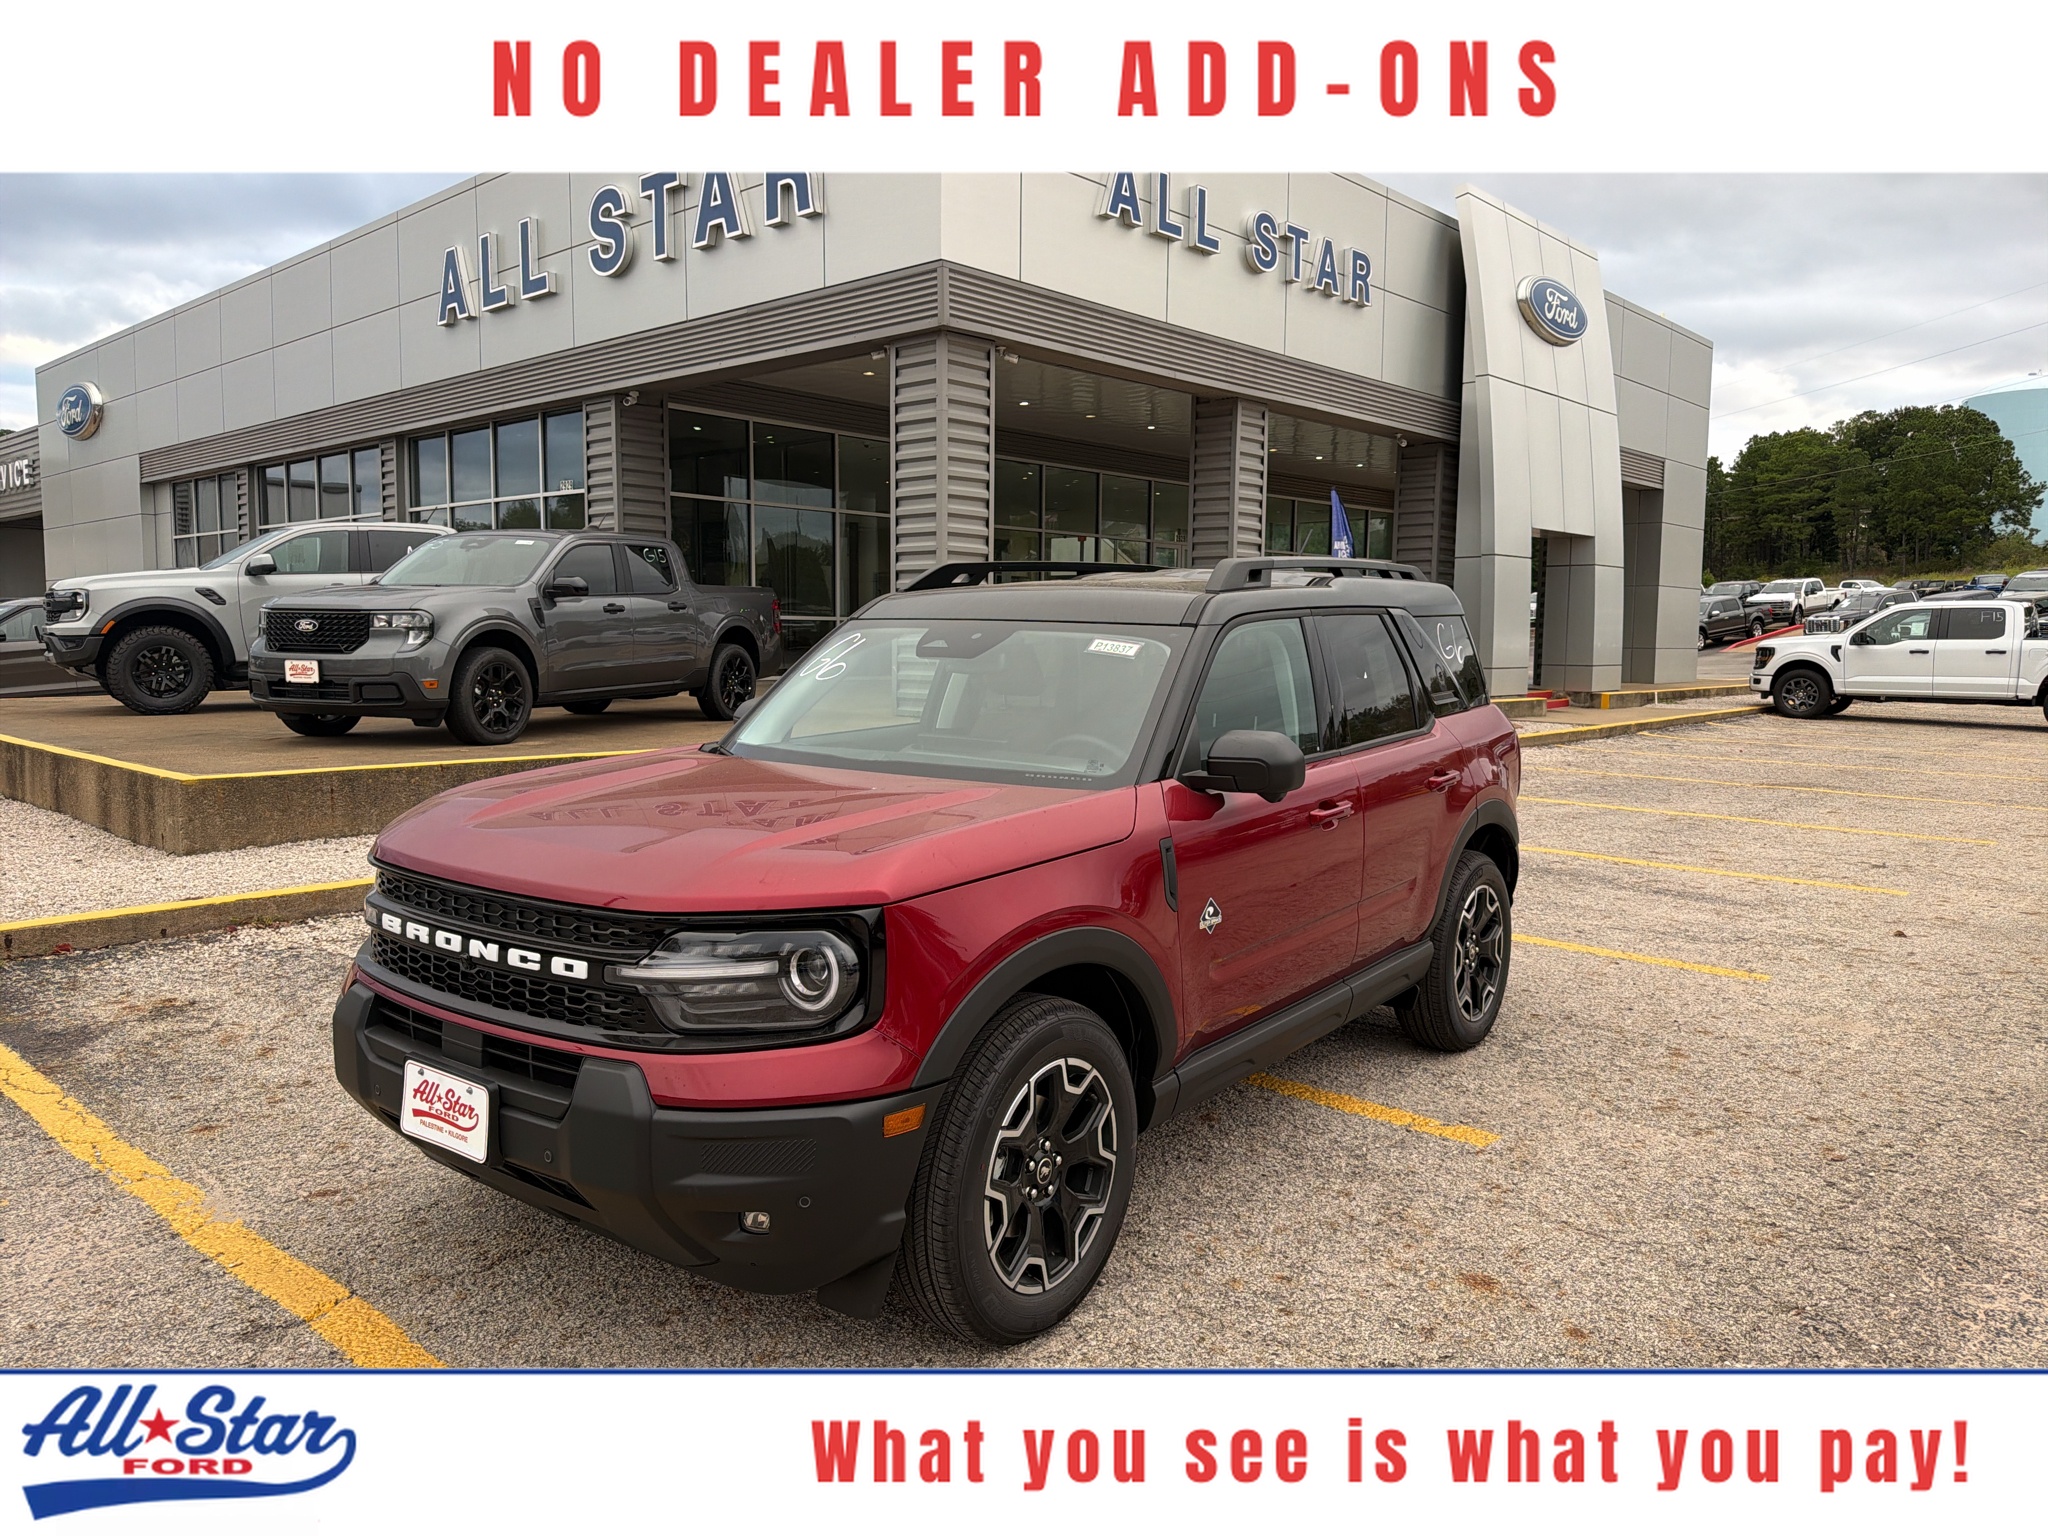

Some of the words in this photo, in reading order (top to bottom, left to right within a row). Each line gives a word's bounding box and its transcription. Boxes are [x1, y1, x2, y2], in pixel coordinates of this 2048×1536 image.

[437, 217, 557, 327] ALL
[588, 172, 823, 278] STAR
[1100, 171, 1220, 255] ALL
[1246, 210, 1372, 307] STAR
[1544, 287, 1579, 329] Ford
[60, 394, 83, 428] Ford
[643, 548, 667, 563] G15
[800, 632, 866, 681] G6
[1093, 641, 1134, 654] P13837
[381, 912, 589, 980] BRONCO
[413, 1079, 440, 1106] All
[442, 1088, 478, 1120] Star
[428, 1106, 459, 1122] FORD
[419, 1119, 444, 1133] PALESTINE
[448, 1130, 469, 1143] KILGORE
